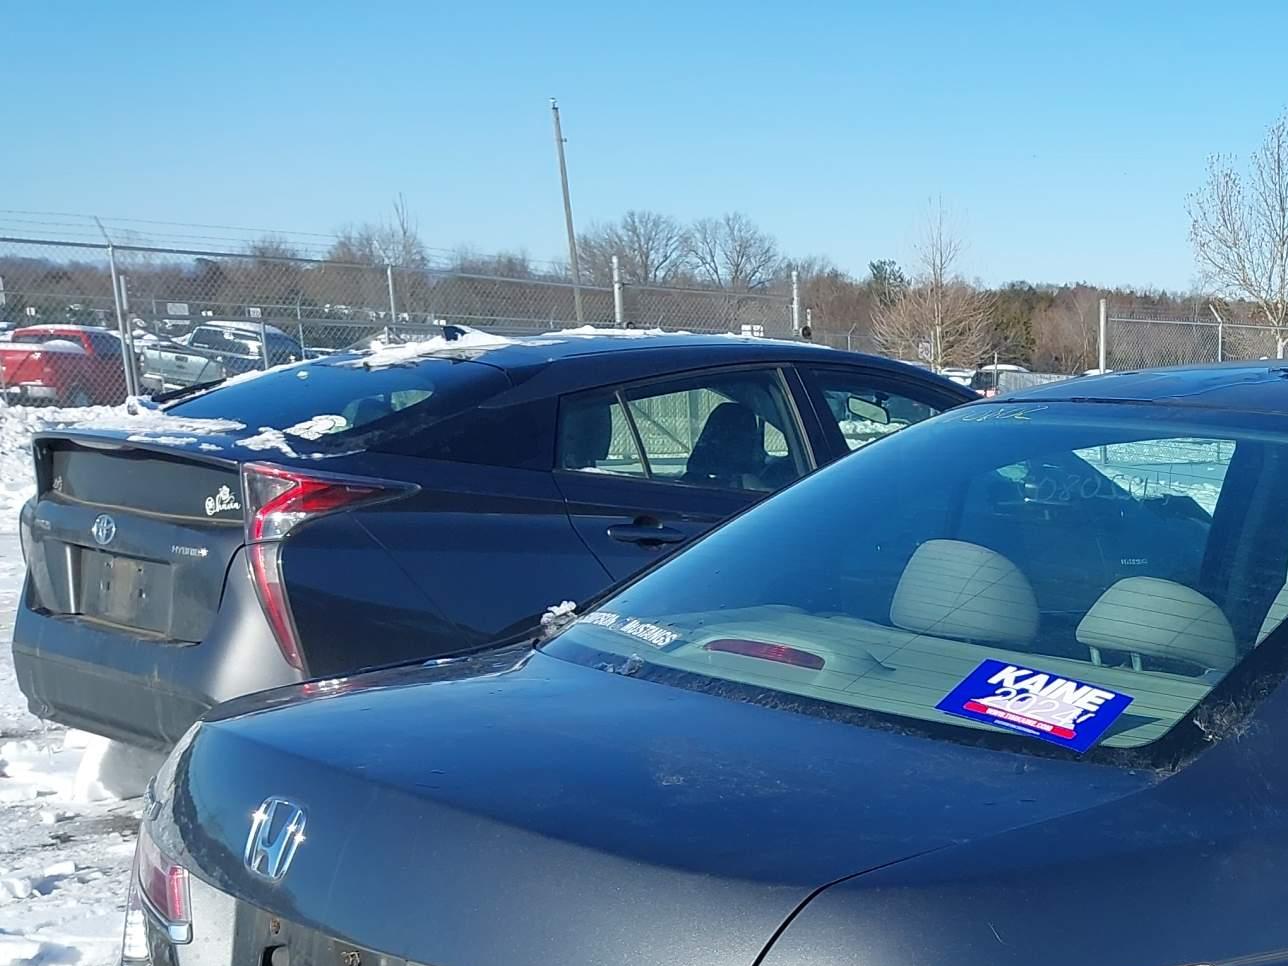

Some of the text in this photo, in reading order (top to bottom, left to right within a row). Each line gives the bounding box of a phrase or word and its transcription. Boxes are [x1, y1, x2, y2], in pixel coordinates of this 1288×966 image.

[170, 545, 208, 557] HYBRI
[987, 666, 1116, 712] KAINE
[989, 687, 1083, 724] 2024
